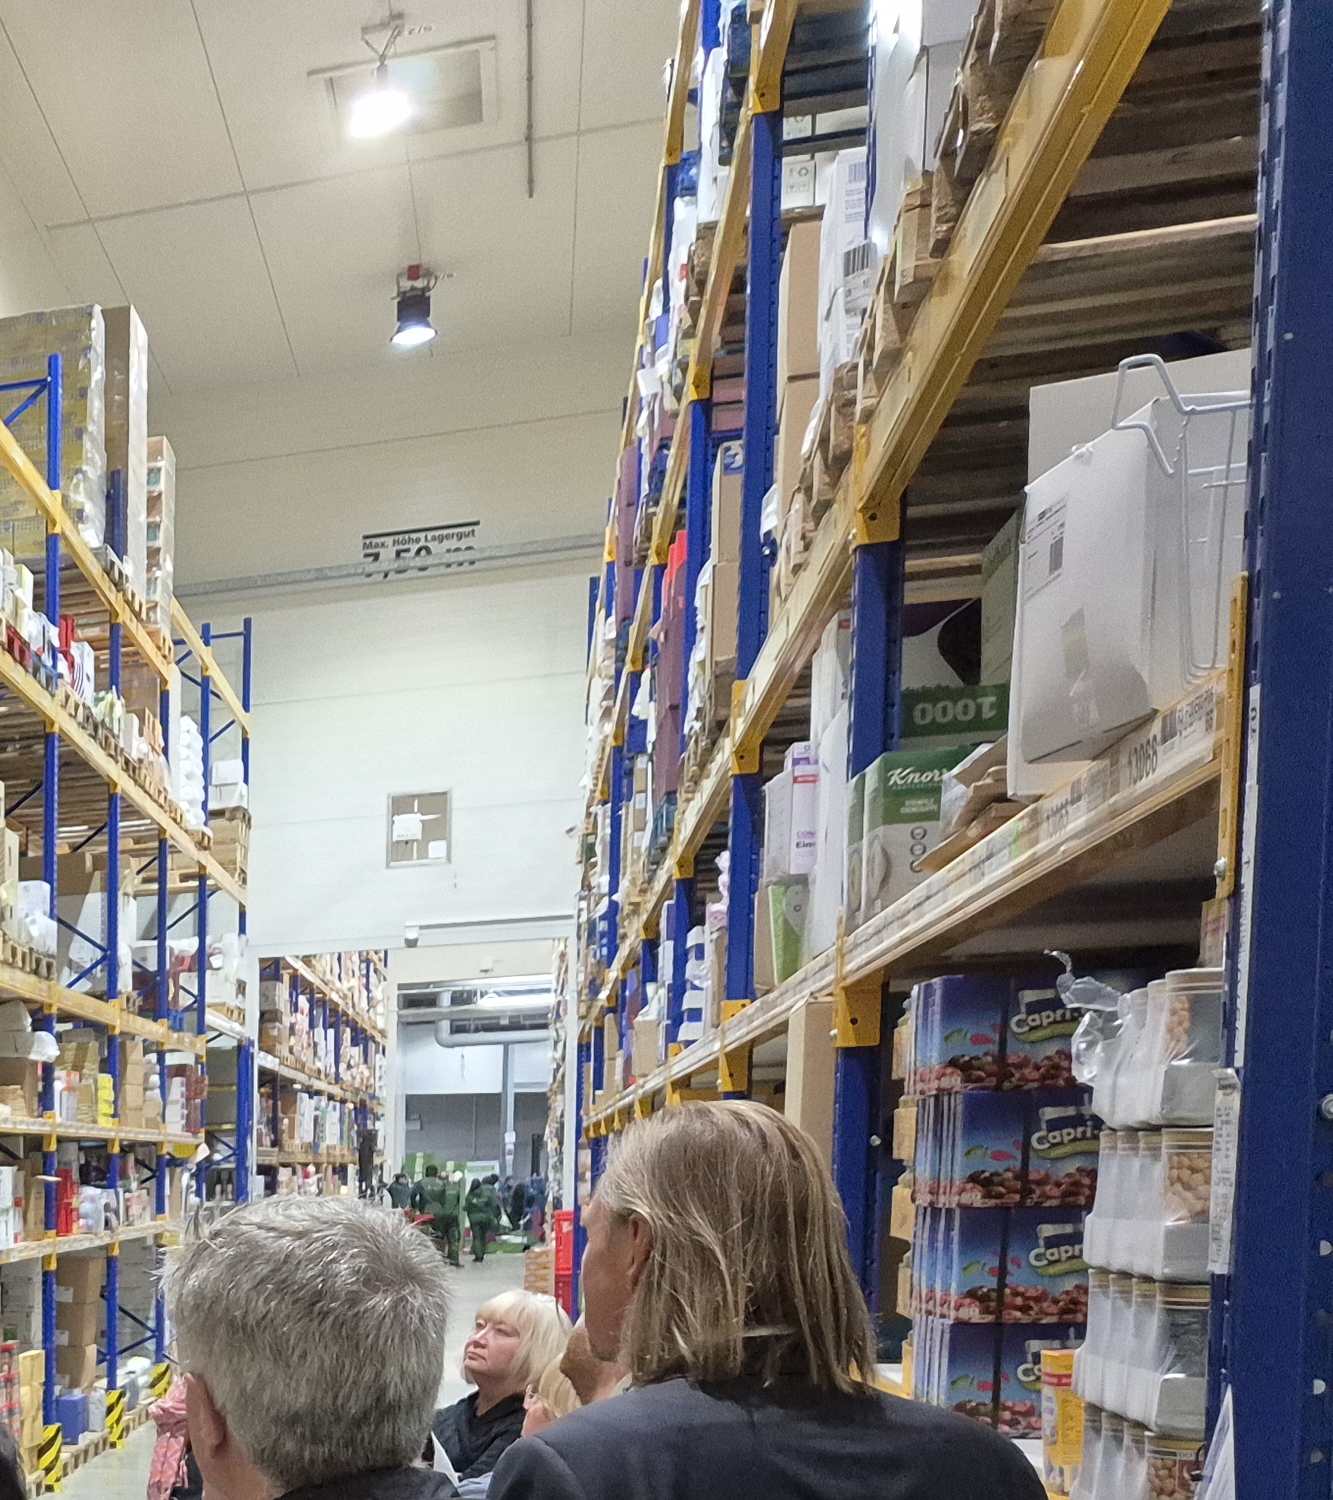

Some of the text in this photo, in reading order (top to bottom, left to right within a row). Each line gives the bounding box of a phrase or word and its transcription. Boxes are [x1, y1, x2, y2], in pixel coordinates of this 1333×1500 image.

[362, 528, 476, 551] Max. Höhe Lagergut
[913, 696, 997, 726] 1000
[1029, 1242, 1082, 1268] Capr
